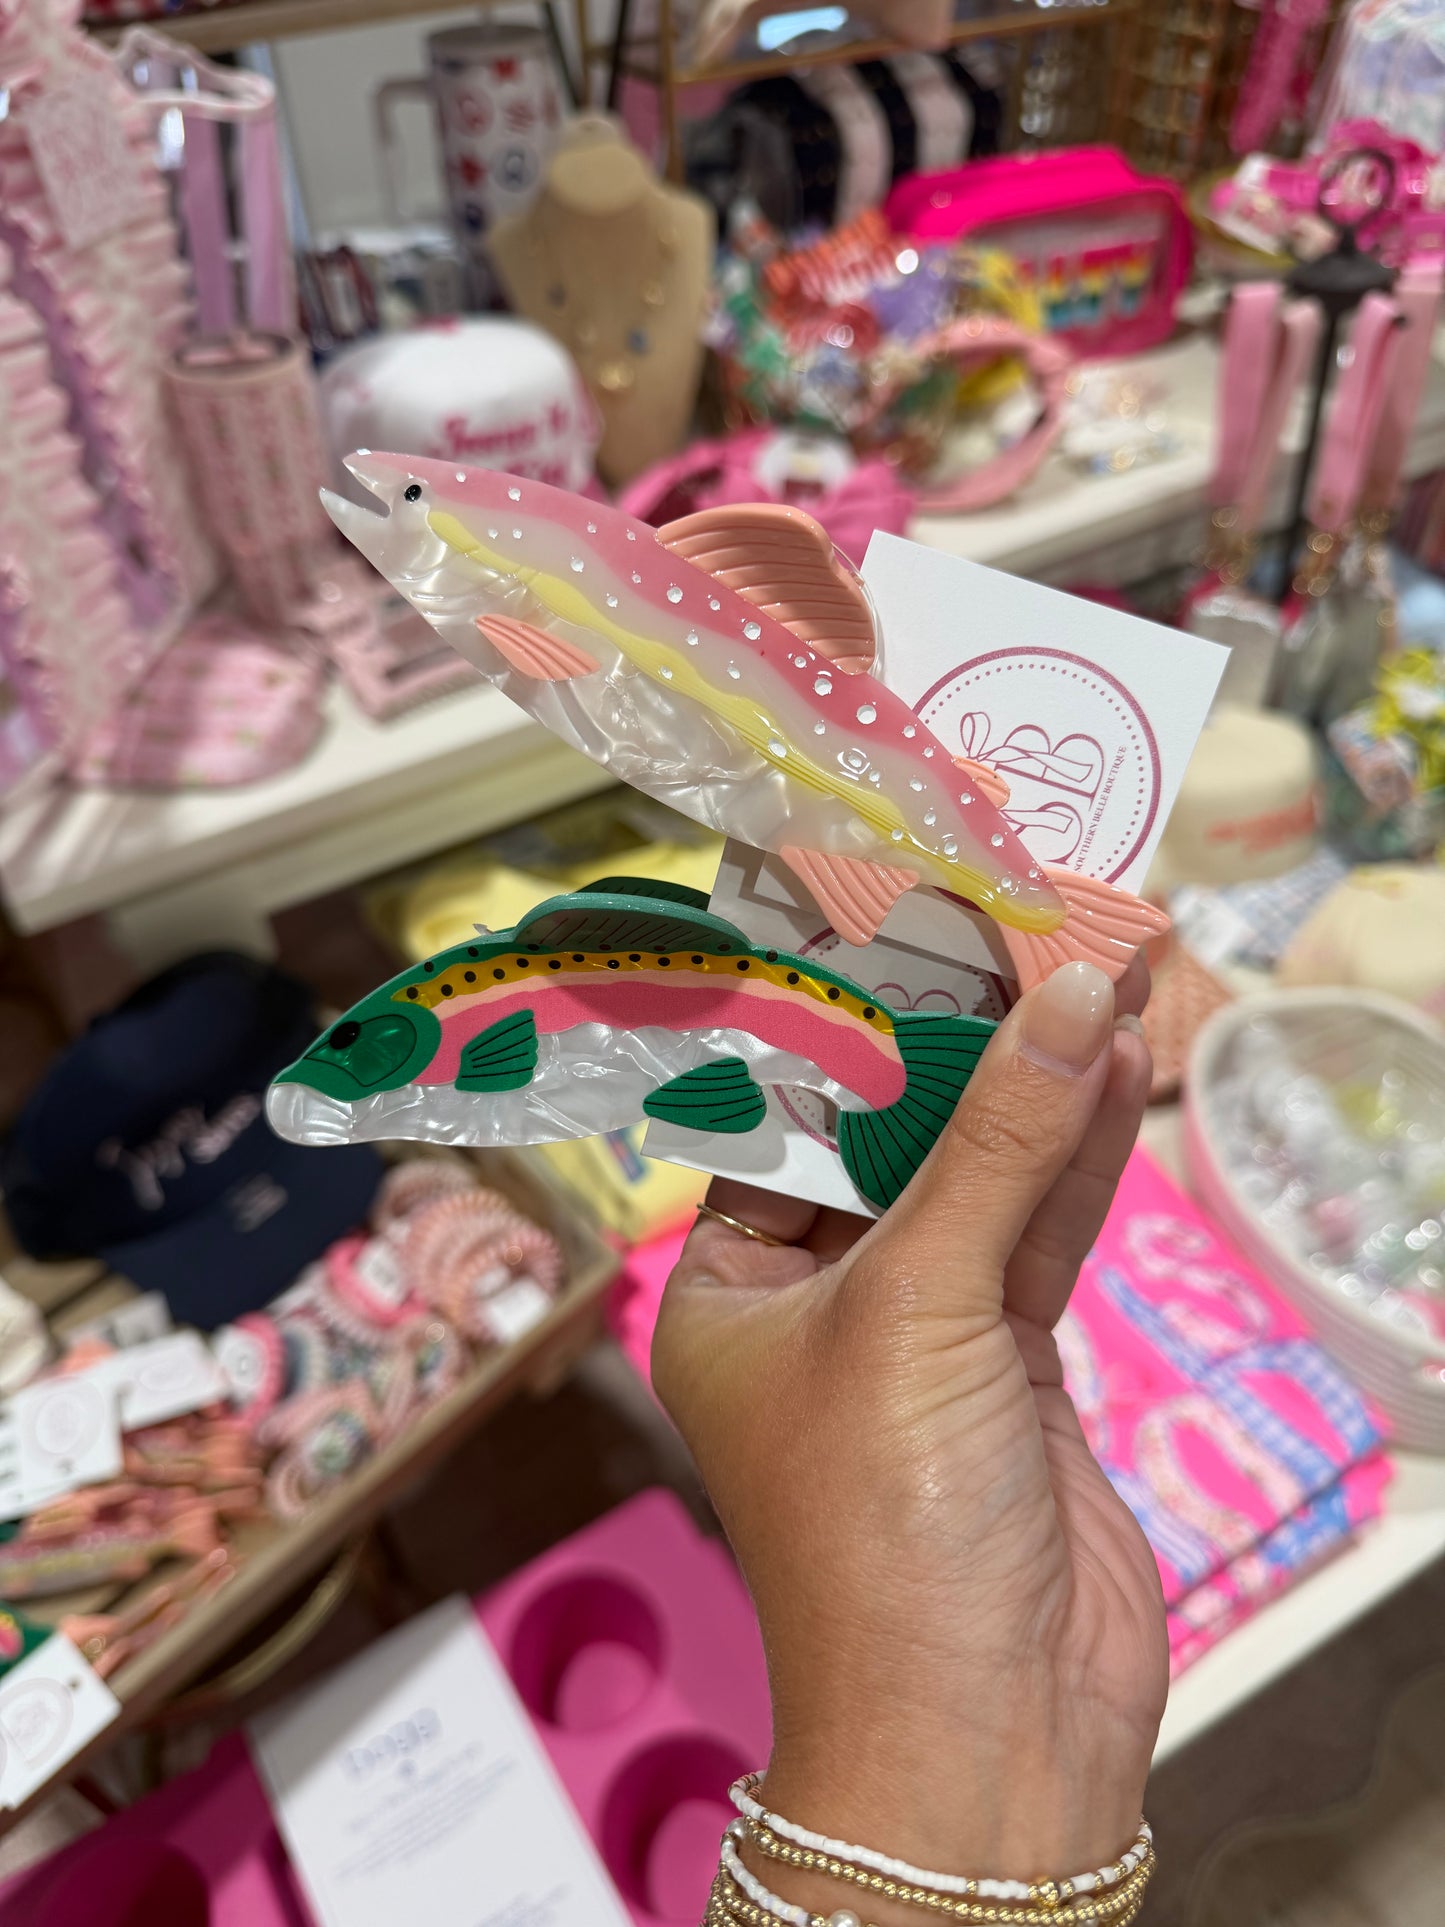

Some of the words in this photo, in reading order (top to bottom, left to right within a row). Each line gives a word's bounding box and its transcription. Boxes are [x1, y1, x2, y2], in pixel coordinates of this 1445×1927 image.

[1074, 822, 1098, 872] SOUTHERN
[1092, 793, 1109, 823] BELLE
[1103, 746, 1126, 794] BOUTIQUE
